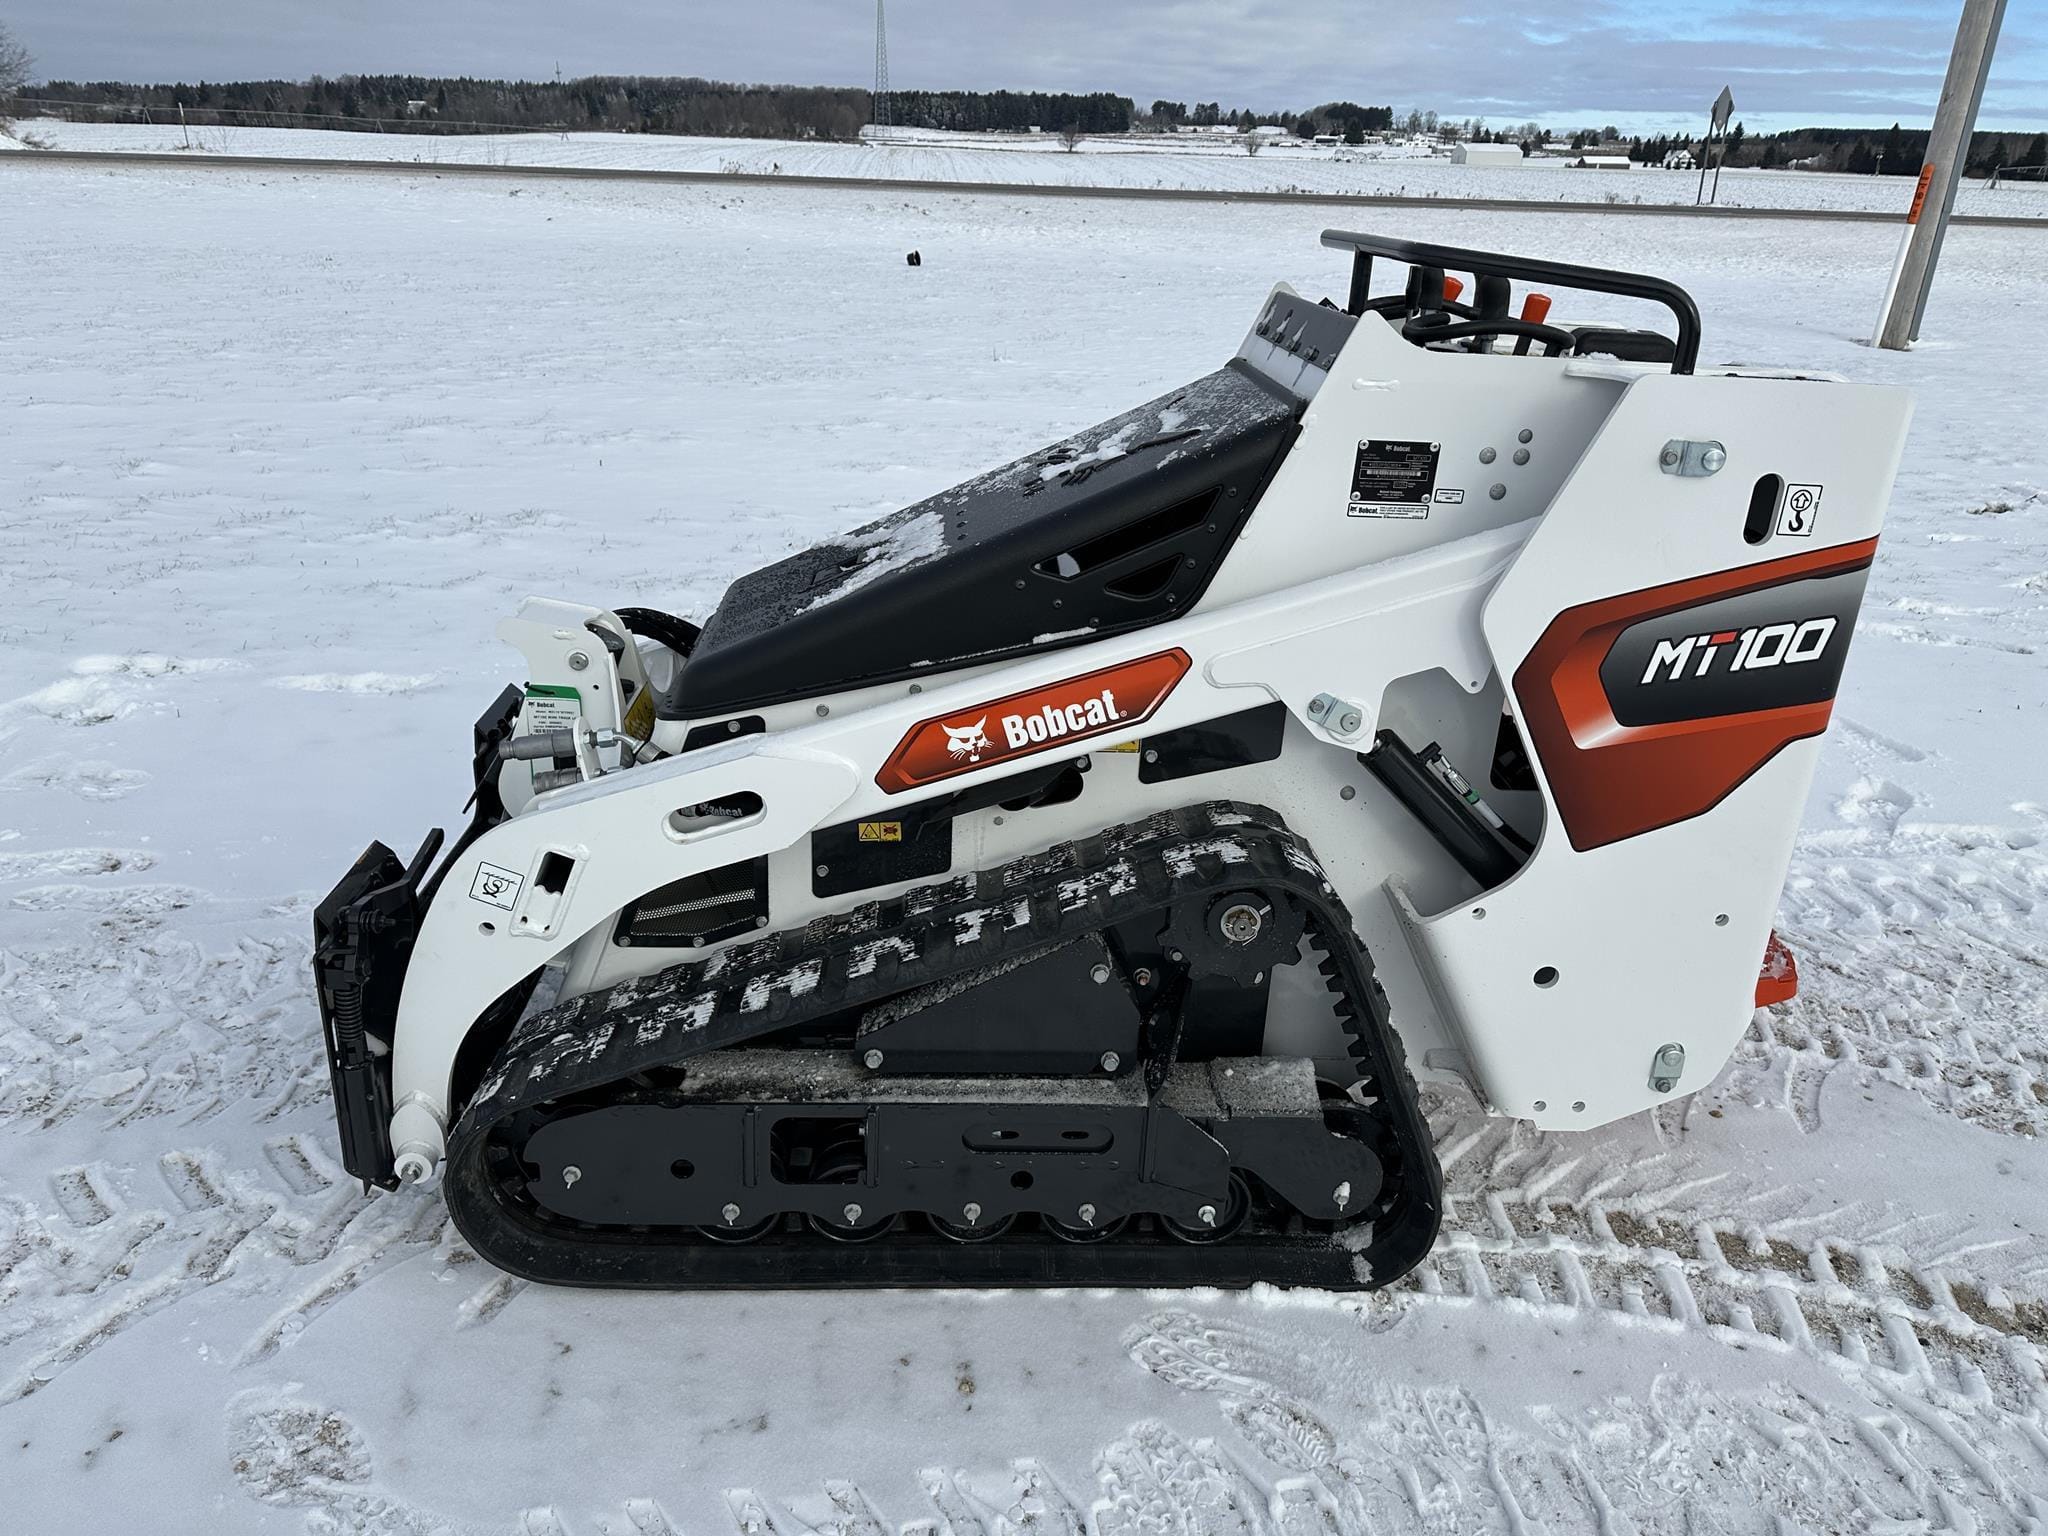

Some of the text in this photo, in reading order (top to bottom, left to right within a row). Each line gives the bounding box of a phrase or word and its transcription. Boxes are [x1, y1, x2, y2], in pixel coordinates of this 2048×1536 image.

[1358, 506, 1378, 514] Bobcat
[1641, 617, 1837, 685] MT100
[1001, 689, 1120, 750] Bobcat
